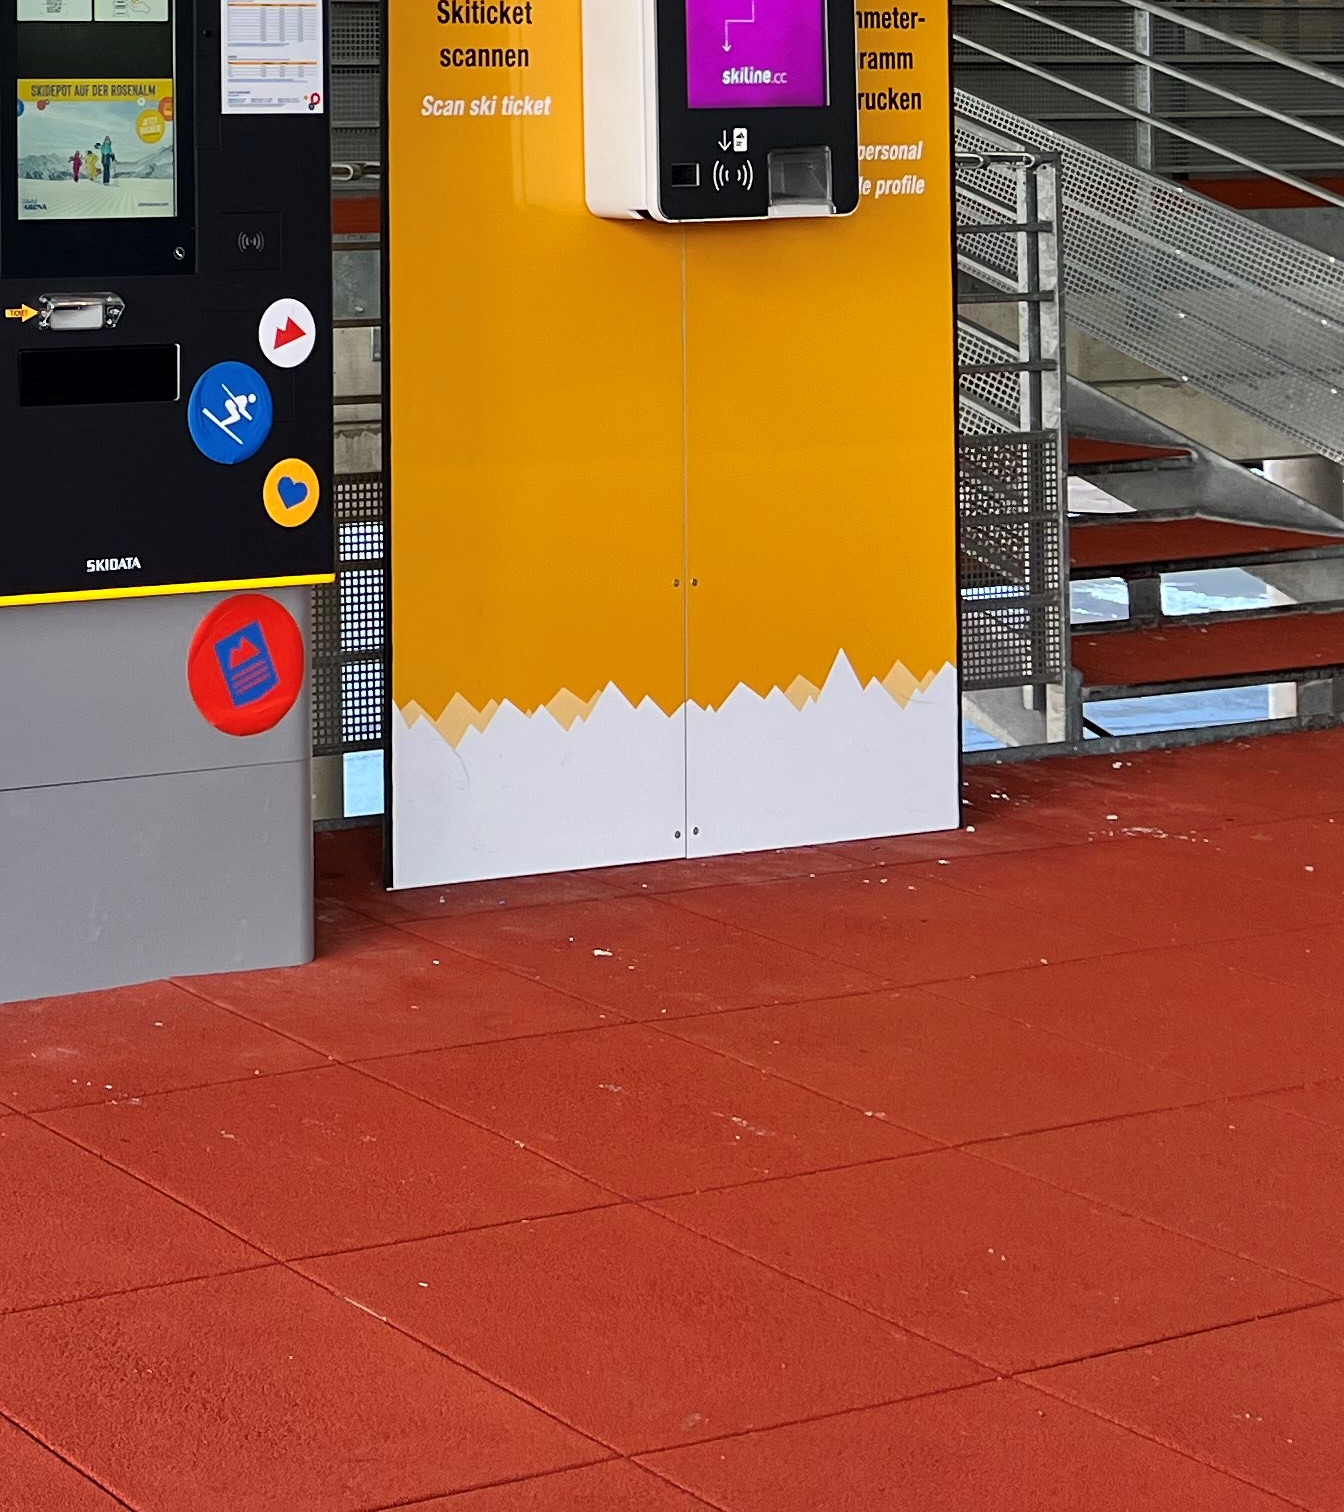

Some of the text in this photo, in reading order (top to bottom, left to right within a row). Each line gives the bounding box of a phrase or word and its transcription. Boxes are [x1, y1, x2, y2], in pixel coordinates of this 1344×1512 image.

[856, 6, 926, 29] nmeter-
[439, 45, 529, 68] scannen
[859, 51, 913, 70] ramm
[721, 66, 788, 85] skiline.cc
[30, 83, 156, 98] SKIDEPOT AUF DER ROSENALM
[858, 88, 923, 111] rucken
[420, 93, 552, 119] Scan ski ticket
[874, 175, 925, 199] profile
[86, 556, 141, 572] SKIDATA
